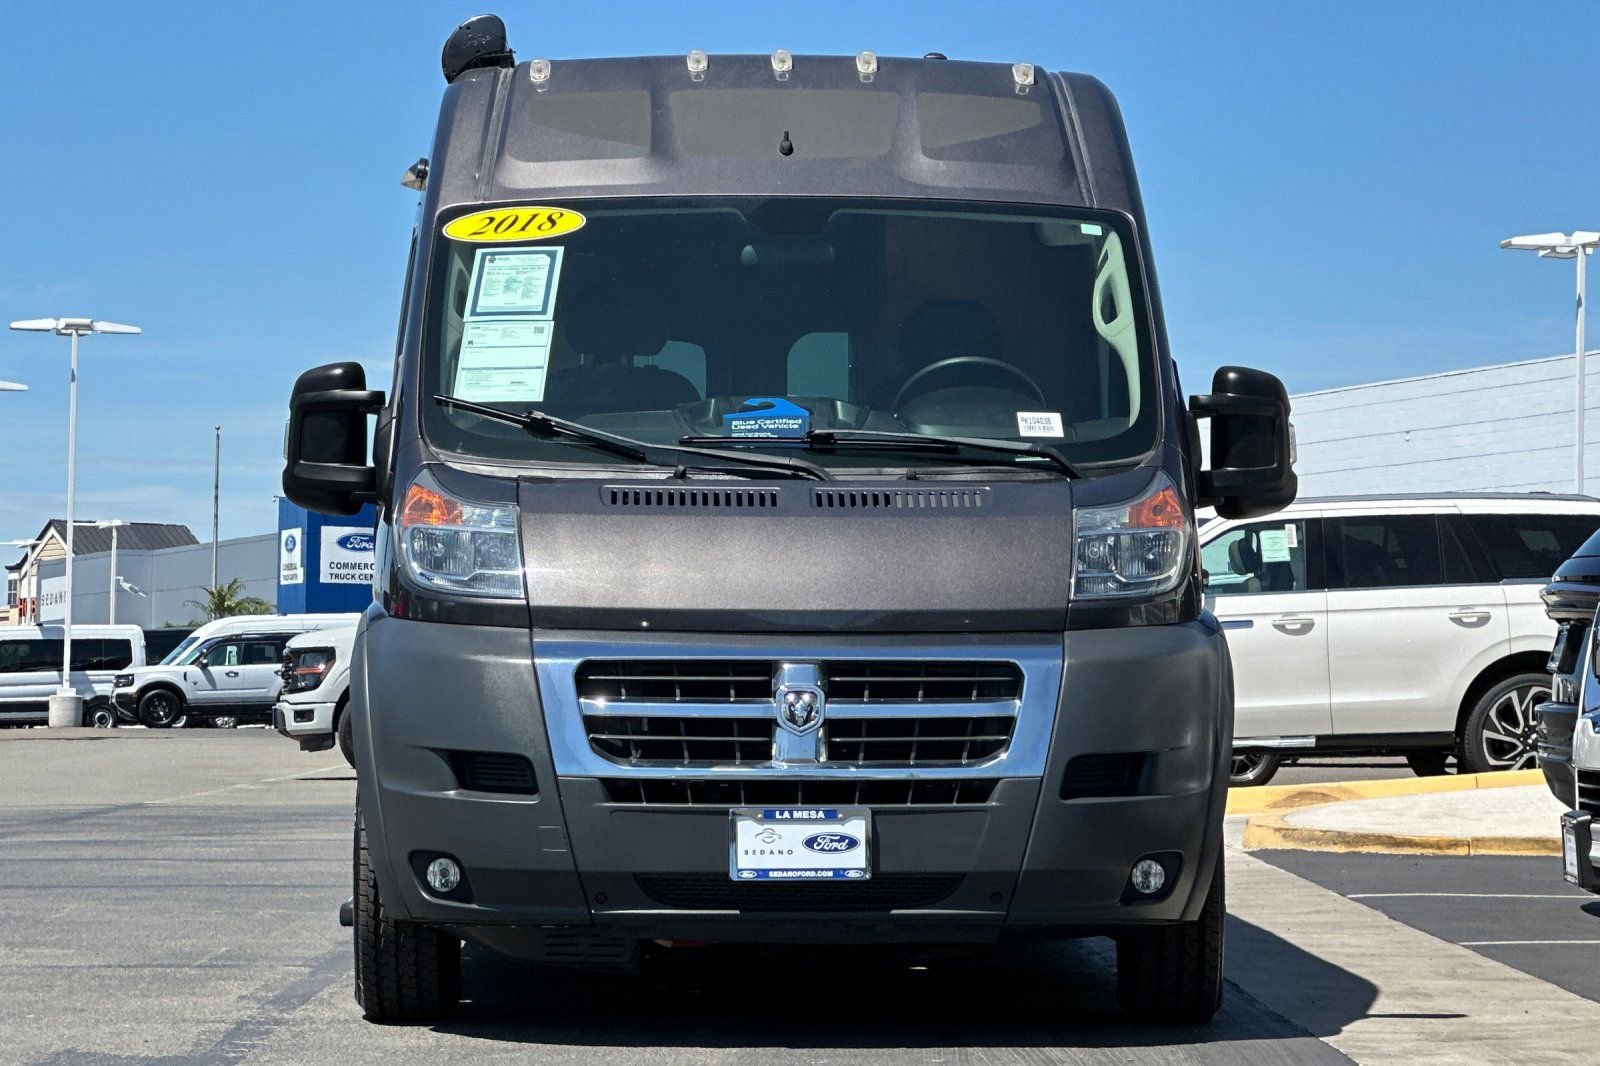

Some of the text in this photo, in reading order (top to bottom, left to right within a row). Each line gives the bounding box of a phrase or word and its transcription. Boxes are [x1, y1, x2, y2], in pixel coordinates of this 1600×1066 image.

[468, 212, 564, 236] 2018
[775, 811, 825, 819] LA MESA
[813, 835, 848, 850] Ford
[768, 870, 834, 878] SEDANOFORD.COM
